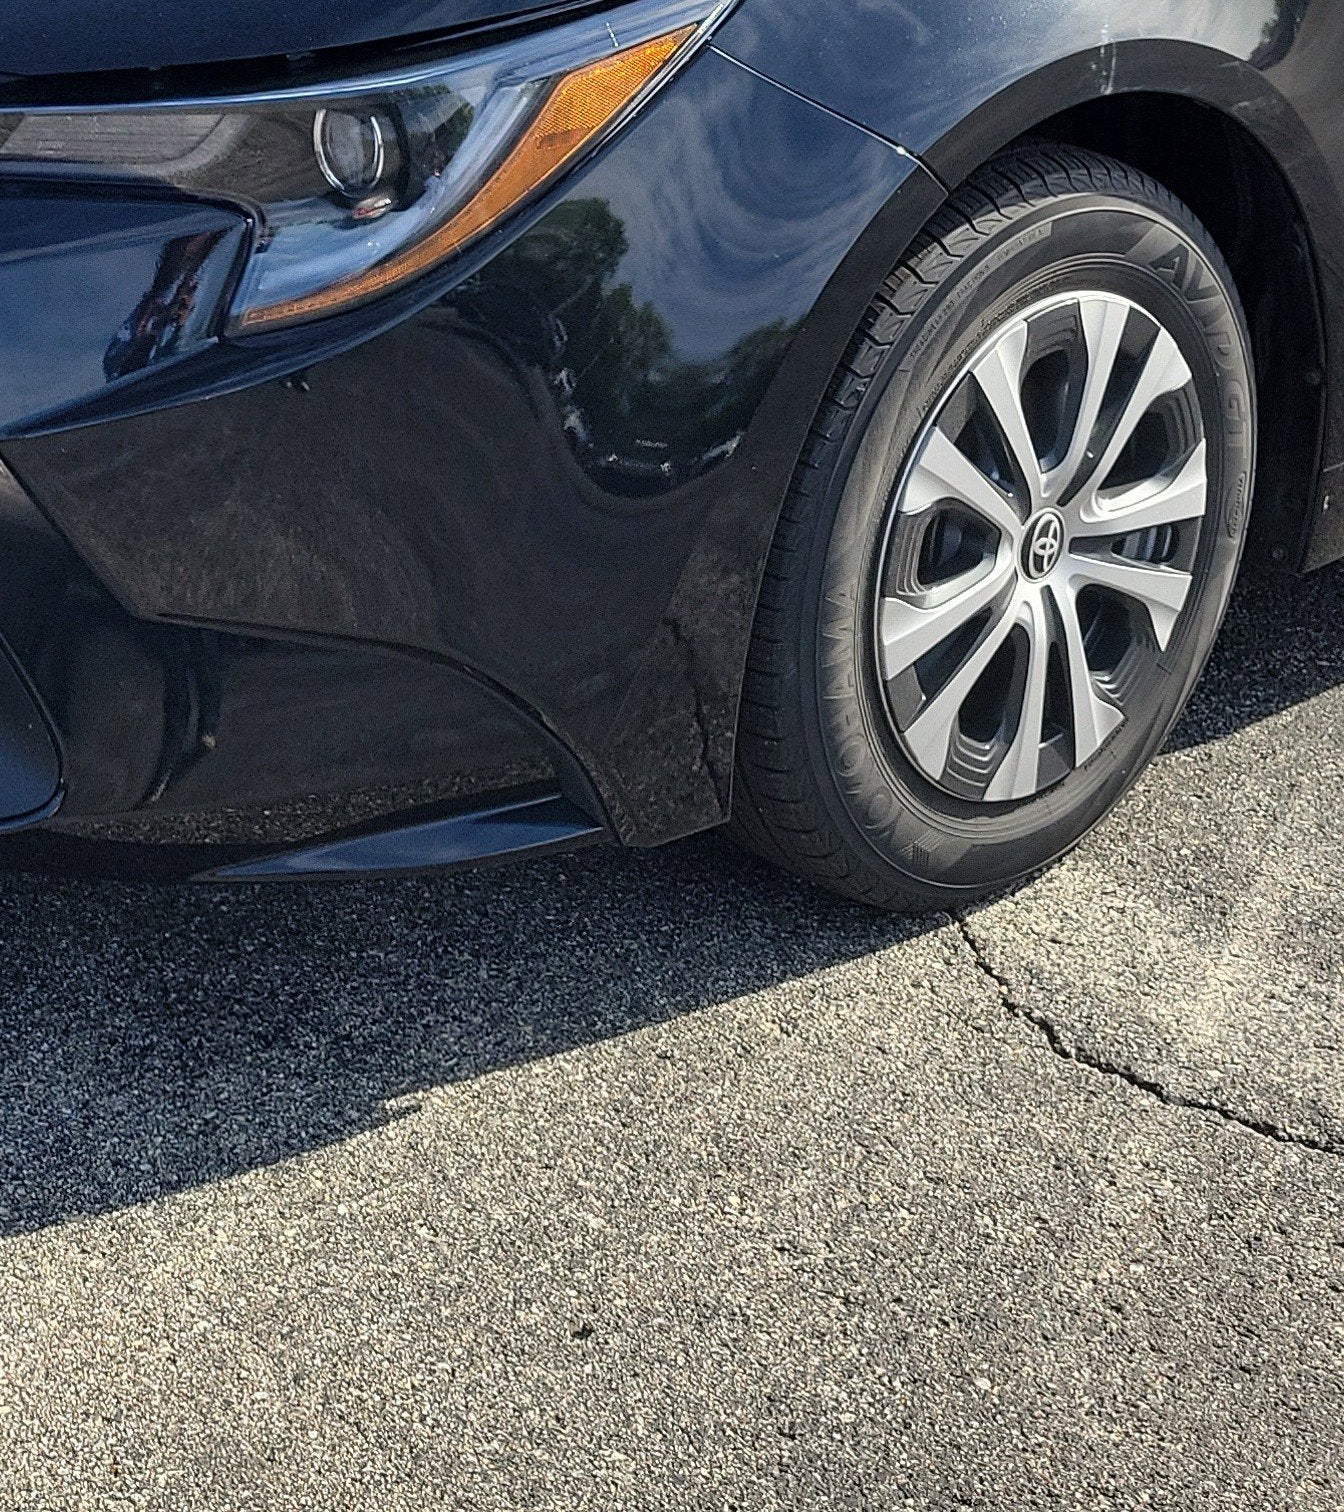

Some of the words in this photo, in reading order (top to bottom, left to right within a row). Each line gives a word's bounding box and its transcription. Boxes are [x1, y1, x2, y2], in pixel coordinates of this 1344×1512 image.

[1149, 243, 1233, 370] AVID
[1224, 379, 1247, 458] GT
[822, 590, 902, 838] YOKOHAMA
